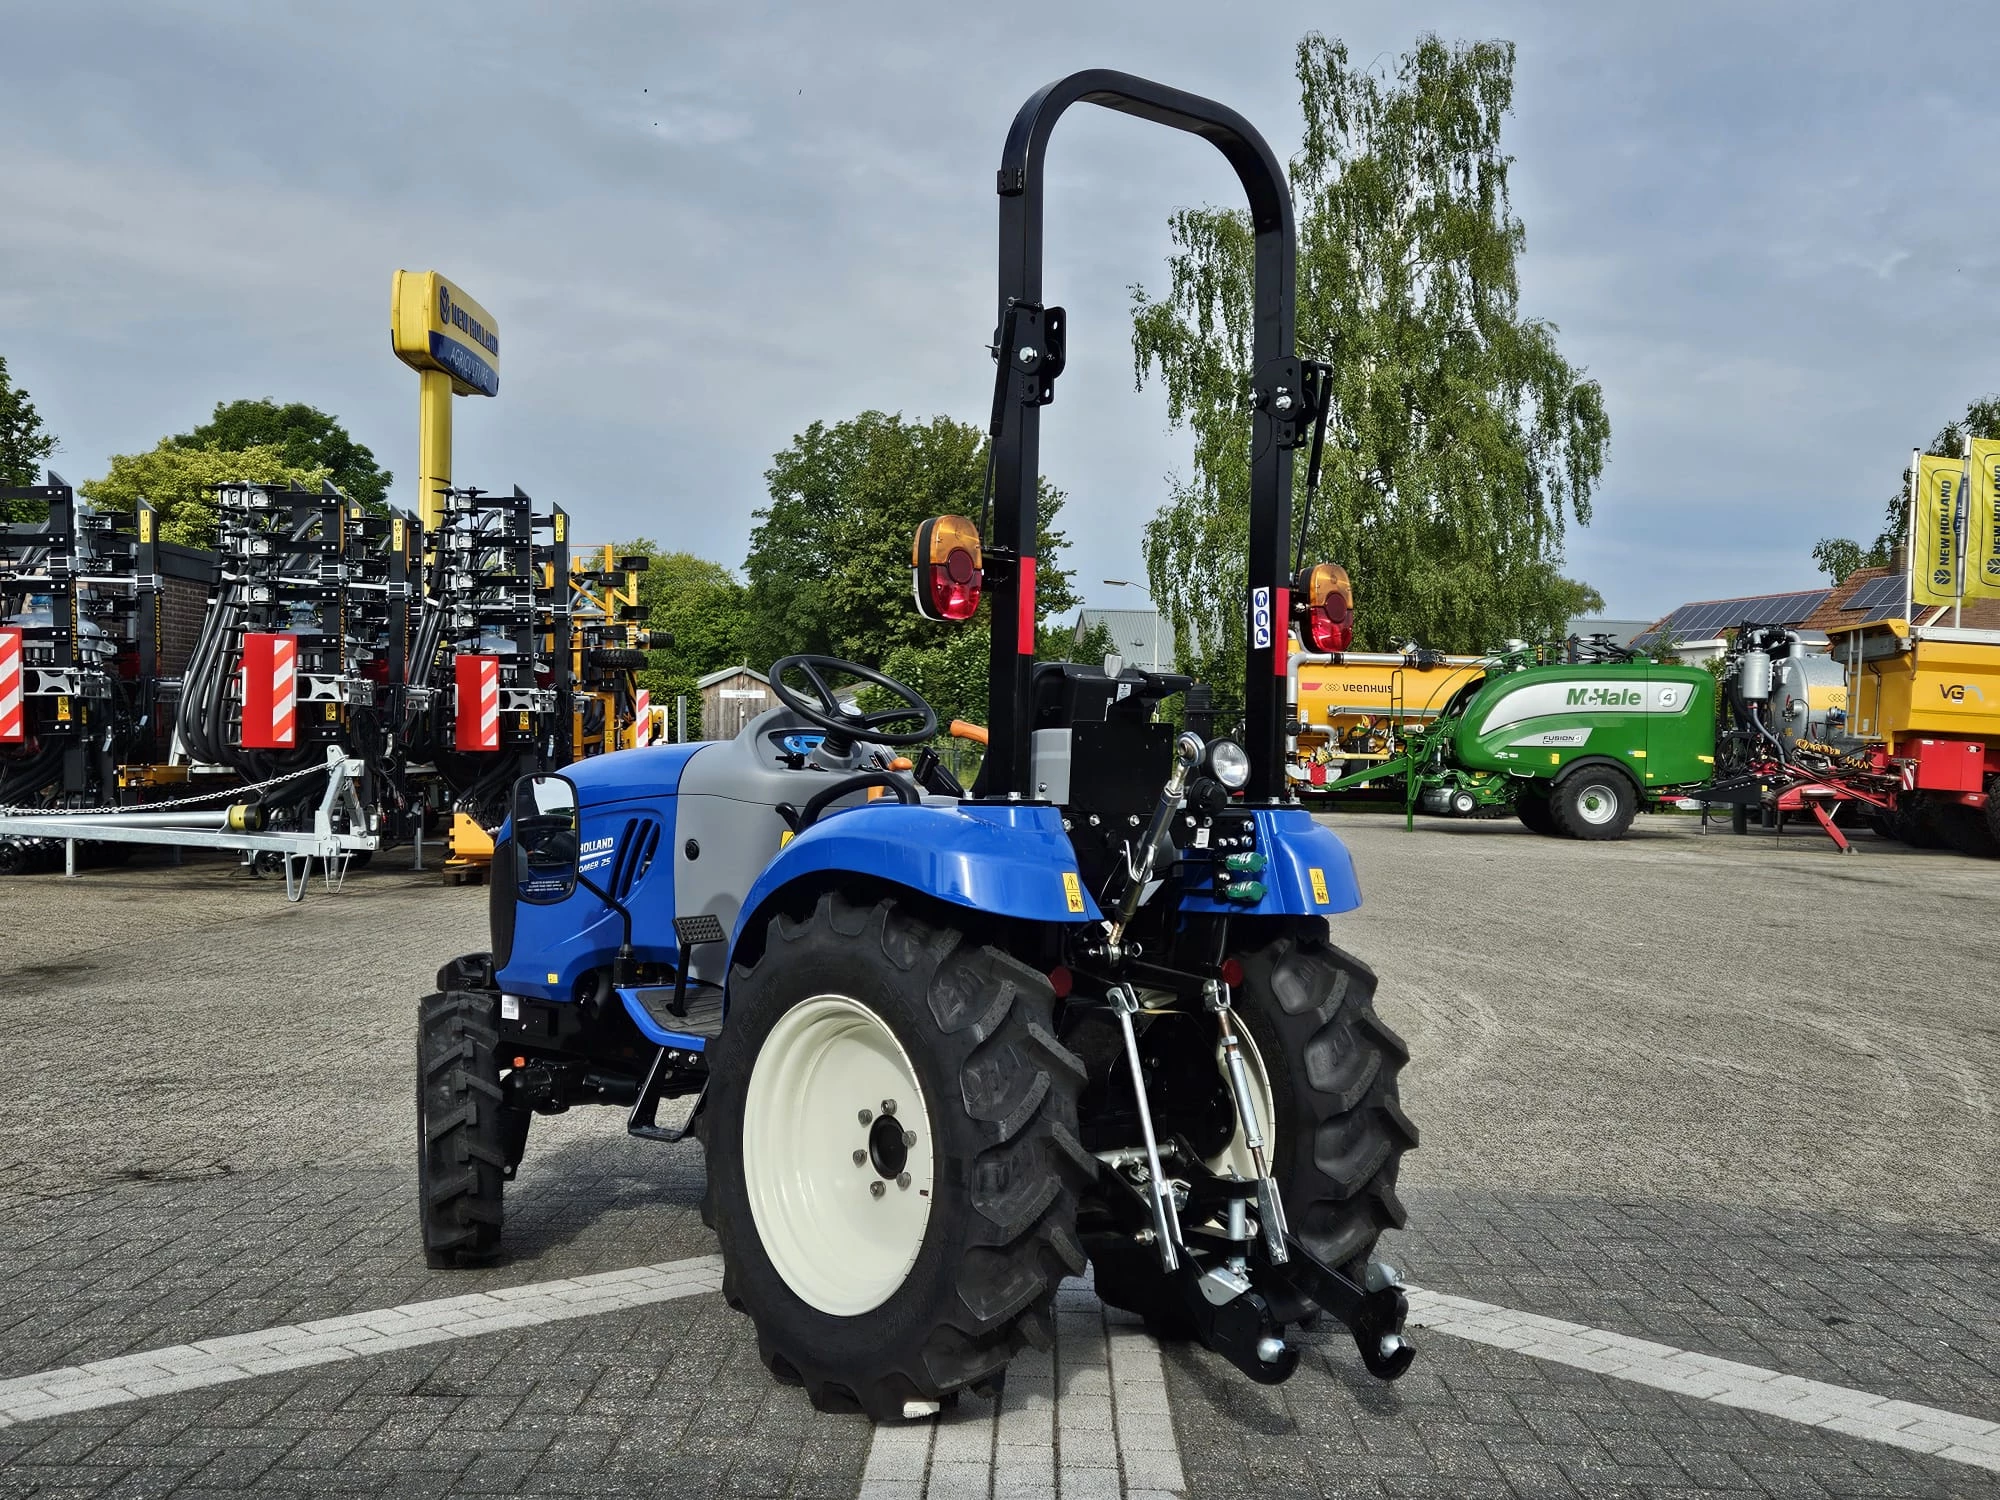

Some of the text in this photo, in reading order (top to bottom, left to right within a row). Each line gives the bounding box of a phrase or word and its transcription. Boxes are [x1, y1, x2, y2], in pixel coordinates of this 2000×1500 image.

[1940, 480, 1951, 566] NEW HOLLAND
[1566, 688, 1641, 705] McHale
[579, 857, 612, 873] OMER 25
